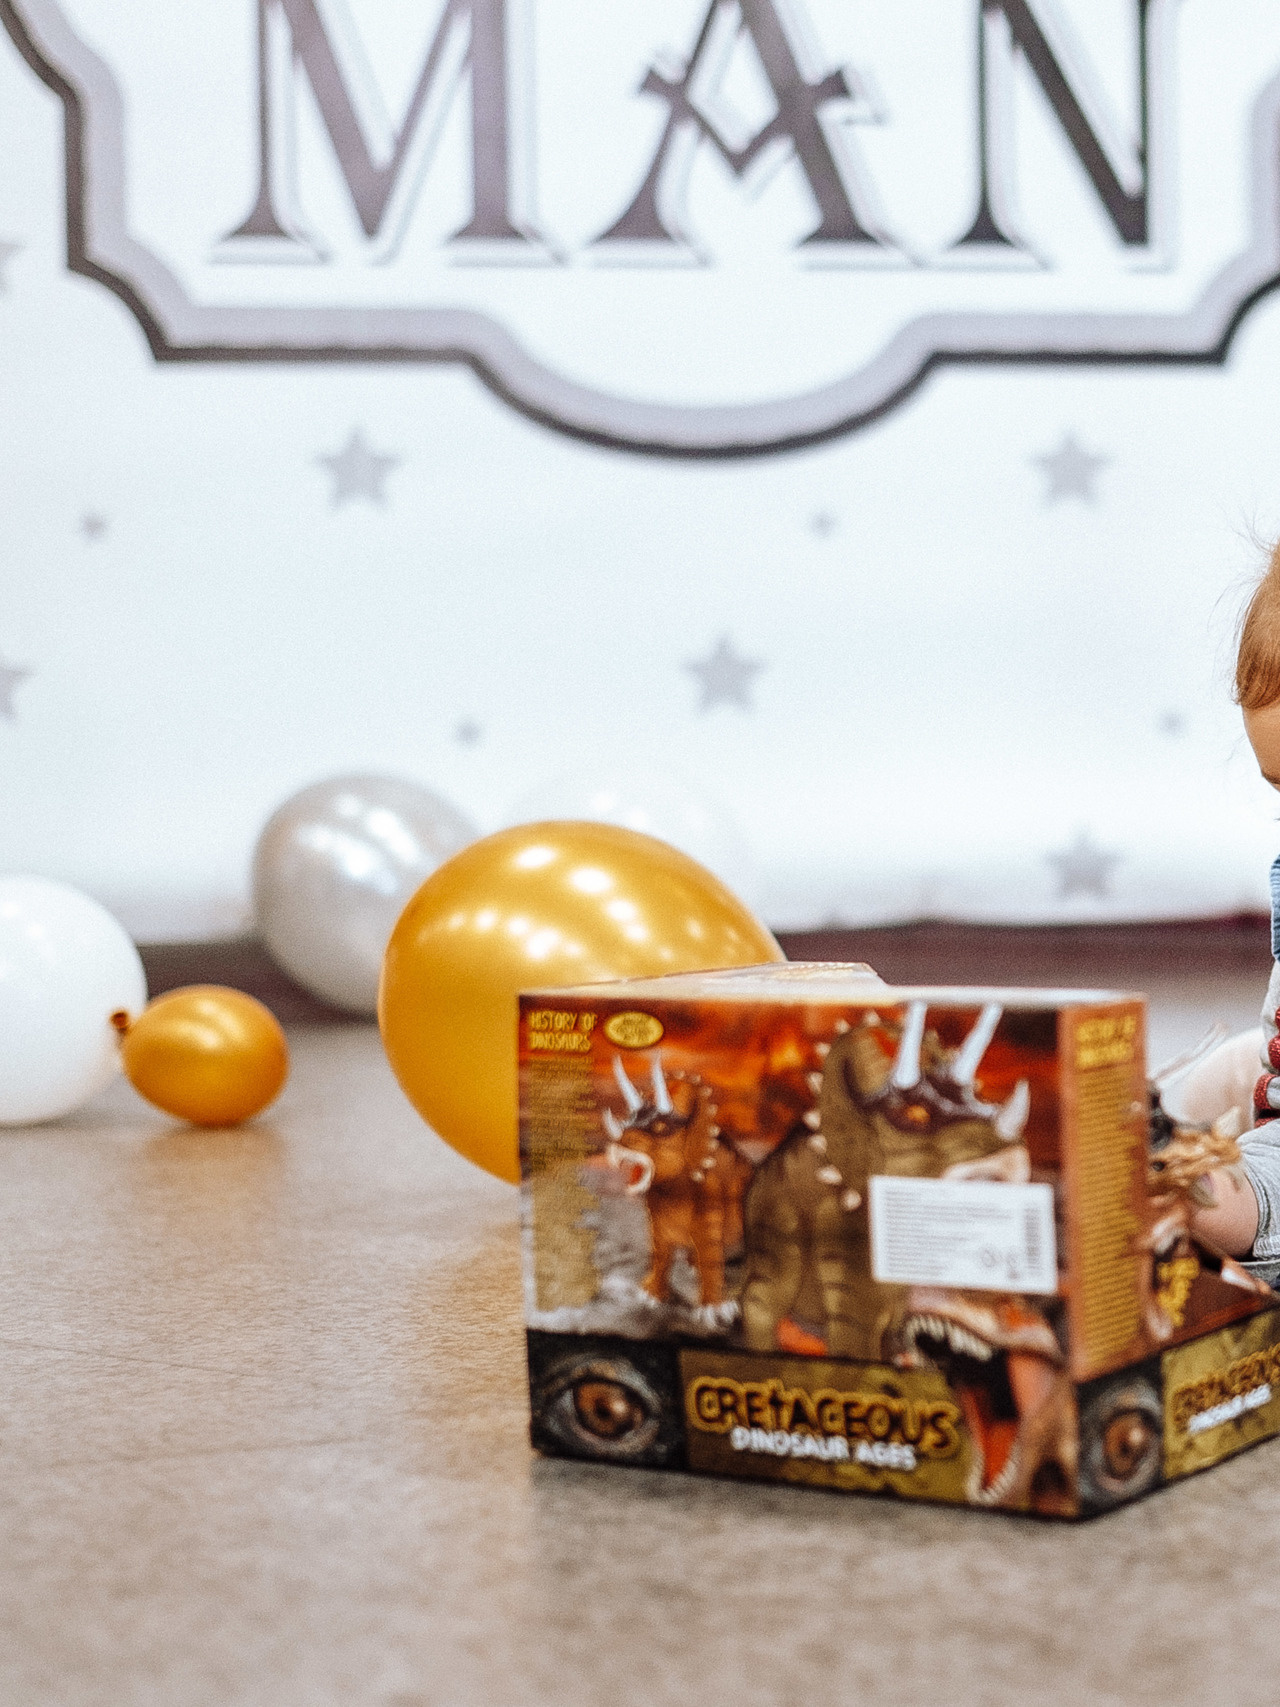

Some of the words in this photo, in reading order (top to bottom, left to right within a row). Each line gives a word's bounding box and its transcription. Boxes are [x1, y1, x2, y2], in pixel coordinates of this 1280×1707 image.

[212, 0, 1168, 262] MAN
[530, 1010, 578, 1031] HISTORY
[580, 1012, 598, 1031] OF
[530, 1031, 592, 1052] DINOSAURS
[730, 1425, 850, 1461] DINOSAUR
[854, 1439, 917, 1471] AGES
